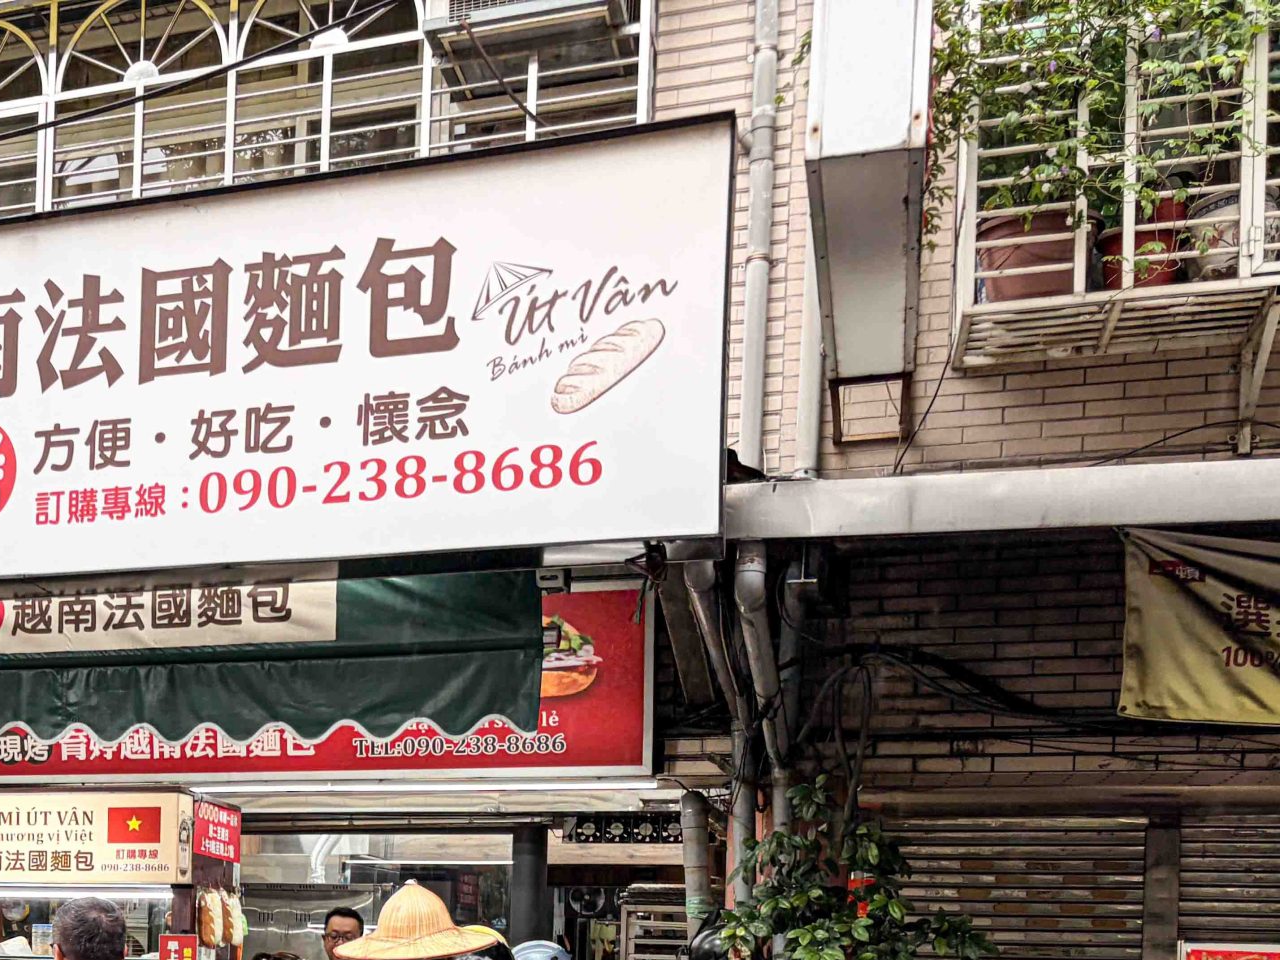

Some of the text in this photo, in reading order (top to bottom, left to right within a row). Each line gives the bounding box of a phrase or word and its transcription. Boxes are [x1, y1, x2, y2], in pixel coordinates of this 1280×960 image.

[572, 264, 678, 325] Vân
[486, 343, 553, 384] Bánh
[11, 579, 294, 636] 越南法國麵包
[28, 808, 53, 827] ÚT
[57, 807, 95, 827] VÂN
[48, 830, 60, 846] vị
[62, 829, 95, 845] Việt
[115, 848, 160, 861] 訂購專線
